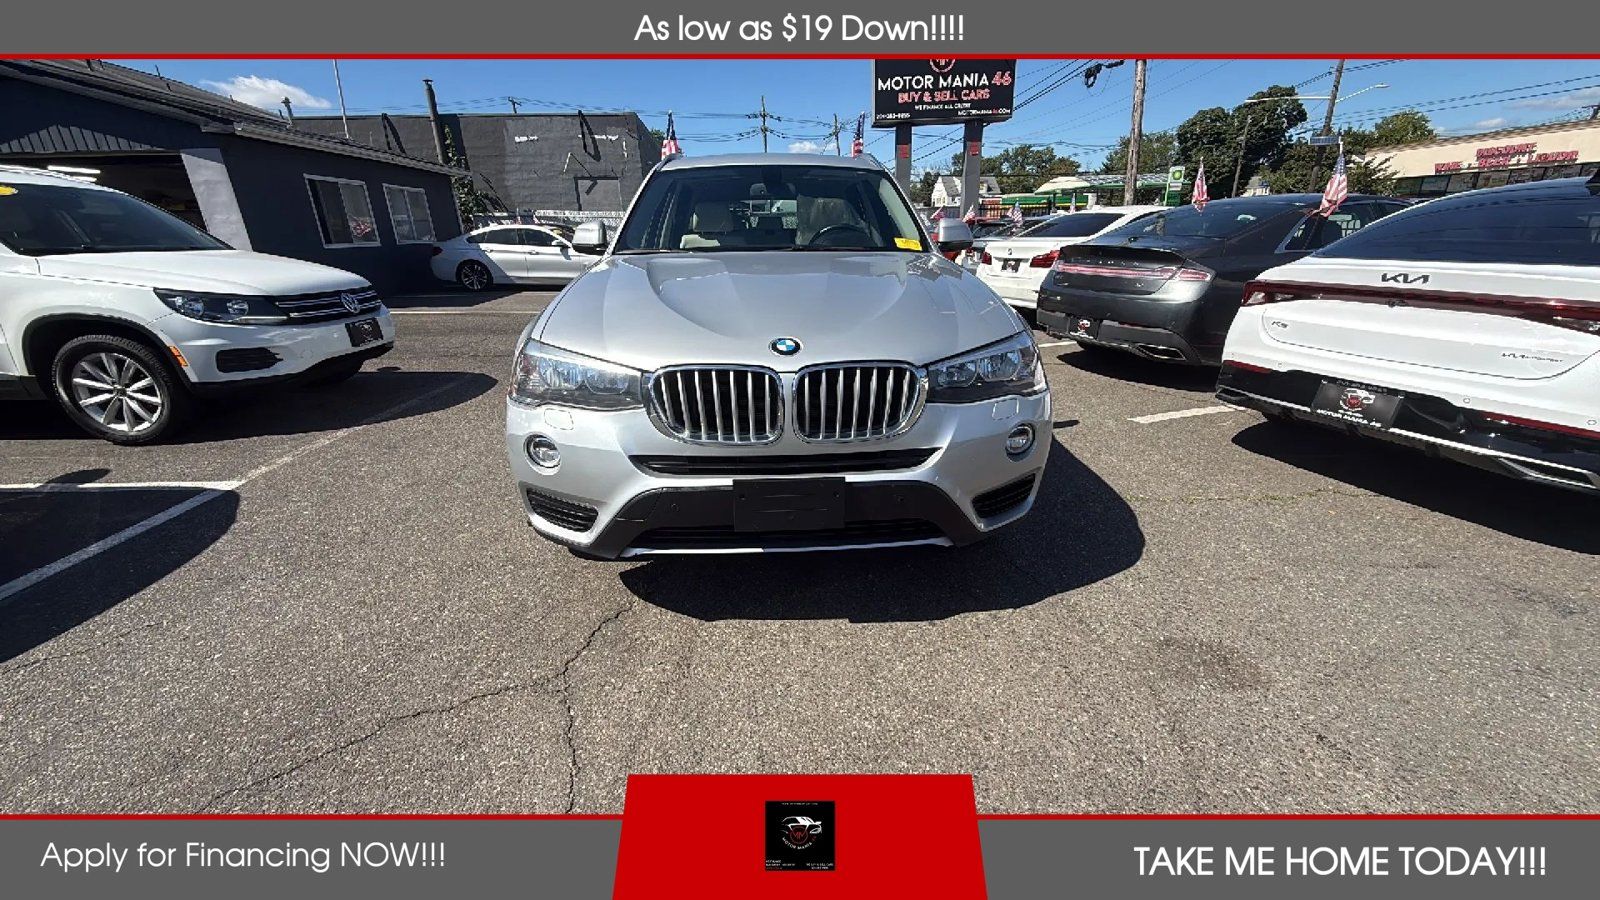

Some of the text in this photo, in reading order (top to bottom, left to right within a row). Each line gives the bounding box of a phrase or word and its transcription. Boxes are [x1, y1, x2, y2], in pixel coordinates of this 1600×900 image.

[877, 71, 1012, 91] MOTOR MANIA 46
[897, 88, 991, 104] BUY & SELL CARS
